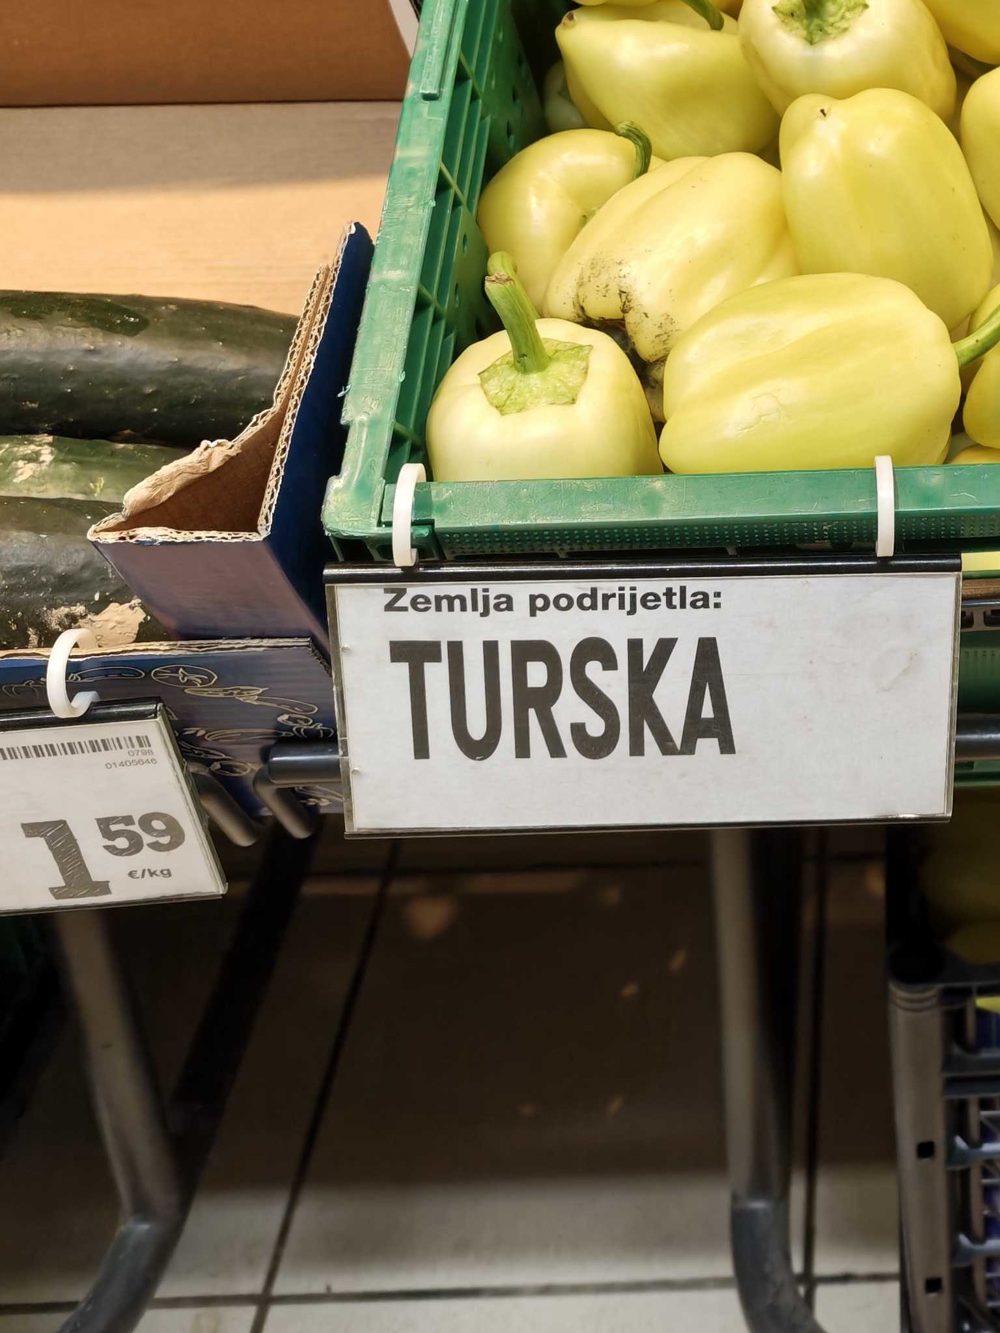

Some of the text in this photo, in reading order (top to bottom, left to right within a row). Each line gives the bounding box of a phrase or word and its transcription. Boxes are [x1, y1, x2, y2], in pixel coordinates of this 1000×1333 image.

[384, 585, 723, 617] Zemlja podrijetla:
[388, 636, 737, 761] TURSKA
[21, 811, 186, 900] 1 59
[127, 868, 172, 879] €/kg
